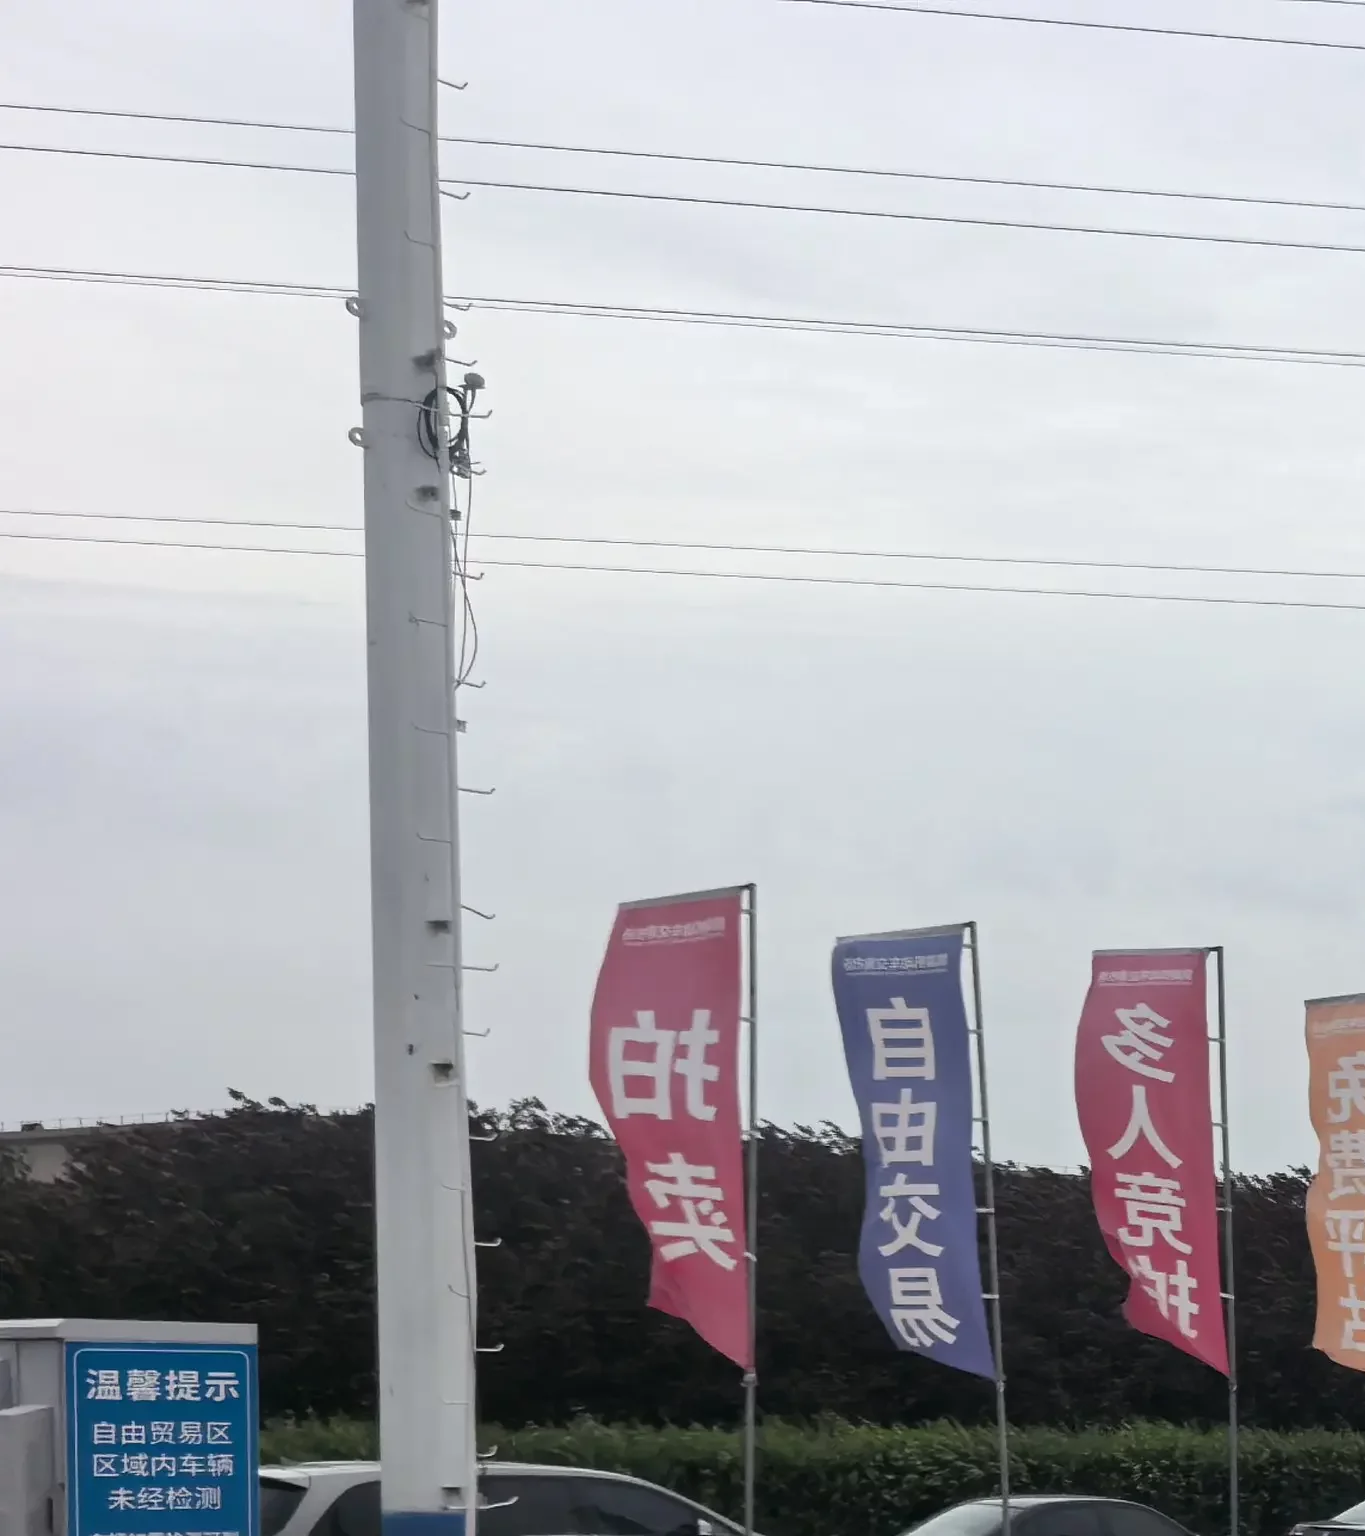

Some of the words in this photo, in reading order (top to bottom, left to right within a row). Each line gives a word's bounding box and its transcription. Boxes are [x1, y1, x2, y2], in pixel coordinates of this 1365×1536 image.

[86, 1368, 240, 1401] 温馨提示
[92, 1420, 233, 1445] 自由贸易区
[92, 1452, 234, 1478] 区域内车辆
[108, 1486, 222, 1510] 未经检测
